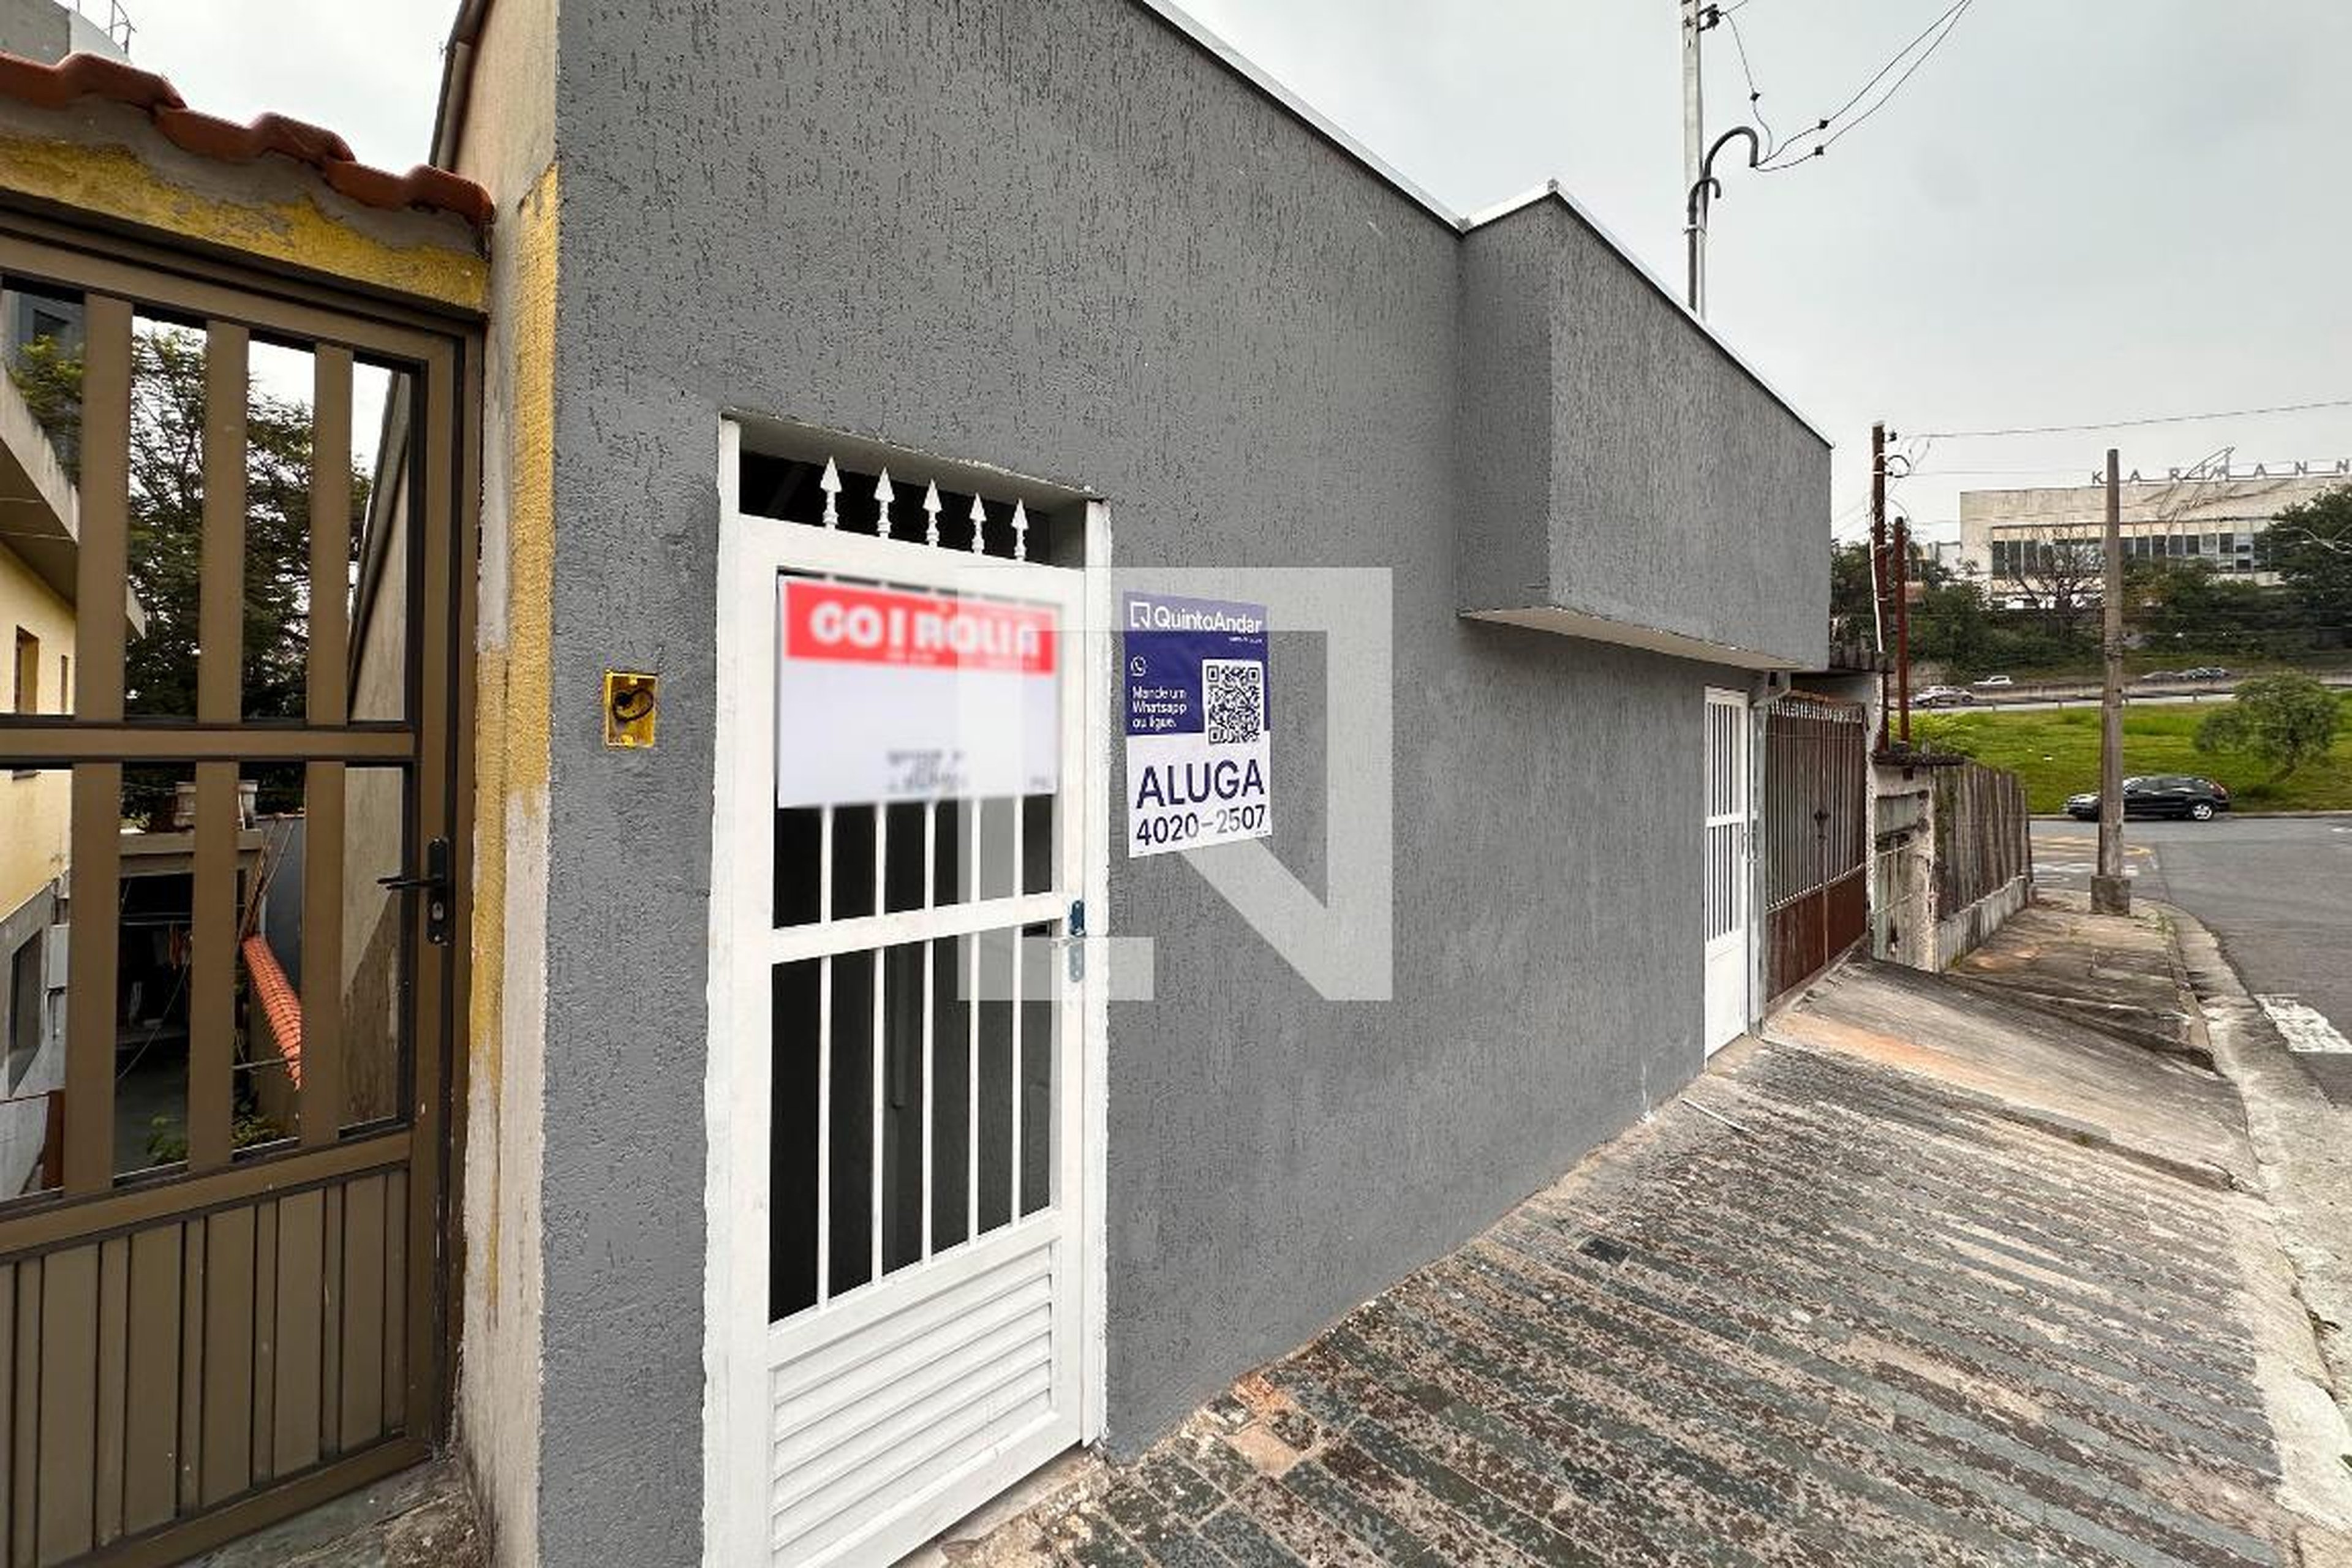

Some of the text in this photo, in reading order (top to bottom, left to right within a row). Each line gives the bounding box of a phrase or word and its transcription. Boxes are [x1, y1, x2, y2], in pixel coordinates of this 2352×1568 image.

[1155, 606, 1262, 634] QuintoAndar
[1133, 686, 1187, 699] Mande um
[1133, 718, 1147, 728] ou
[1136, 758, 1264, 809] ALUGA
[1137, 804, 1265, 846] 4020-2507
